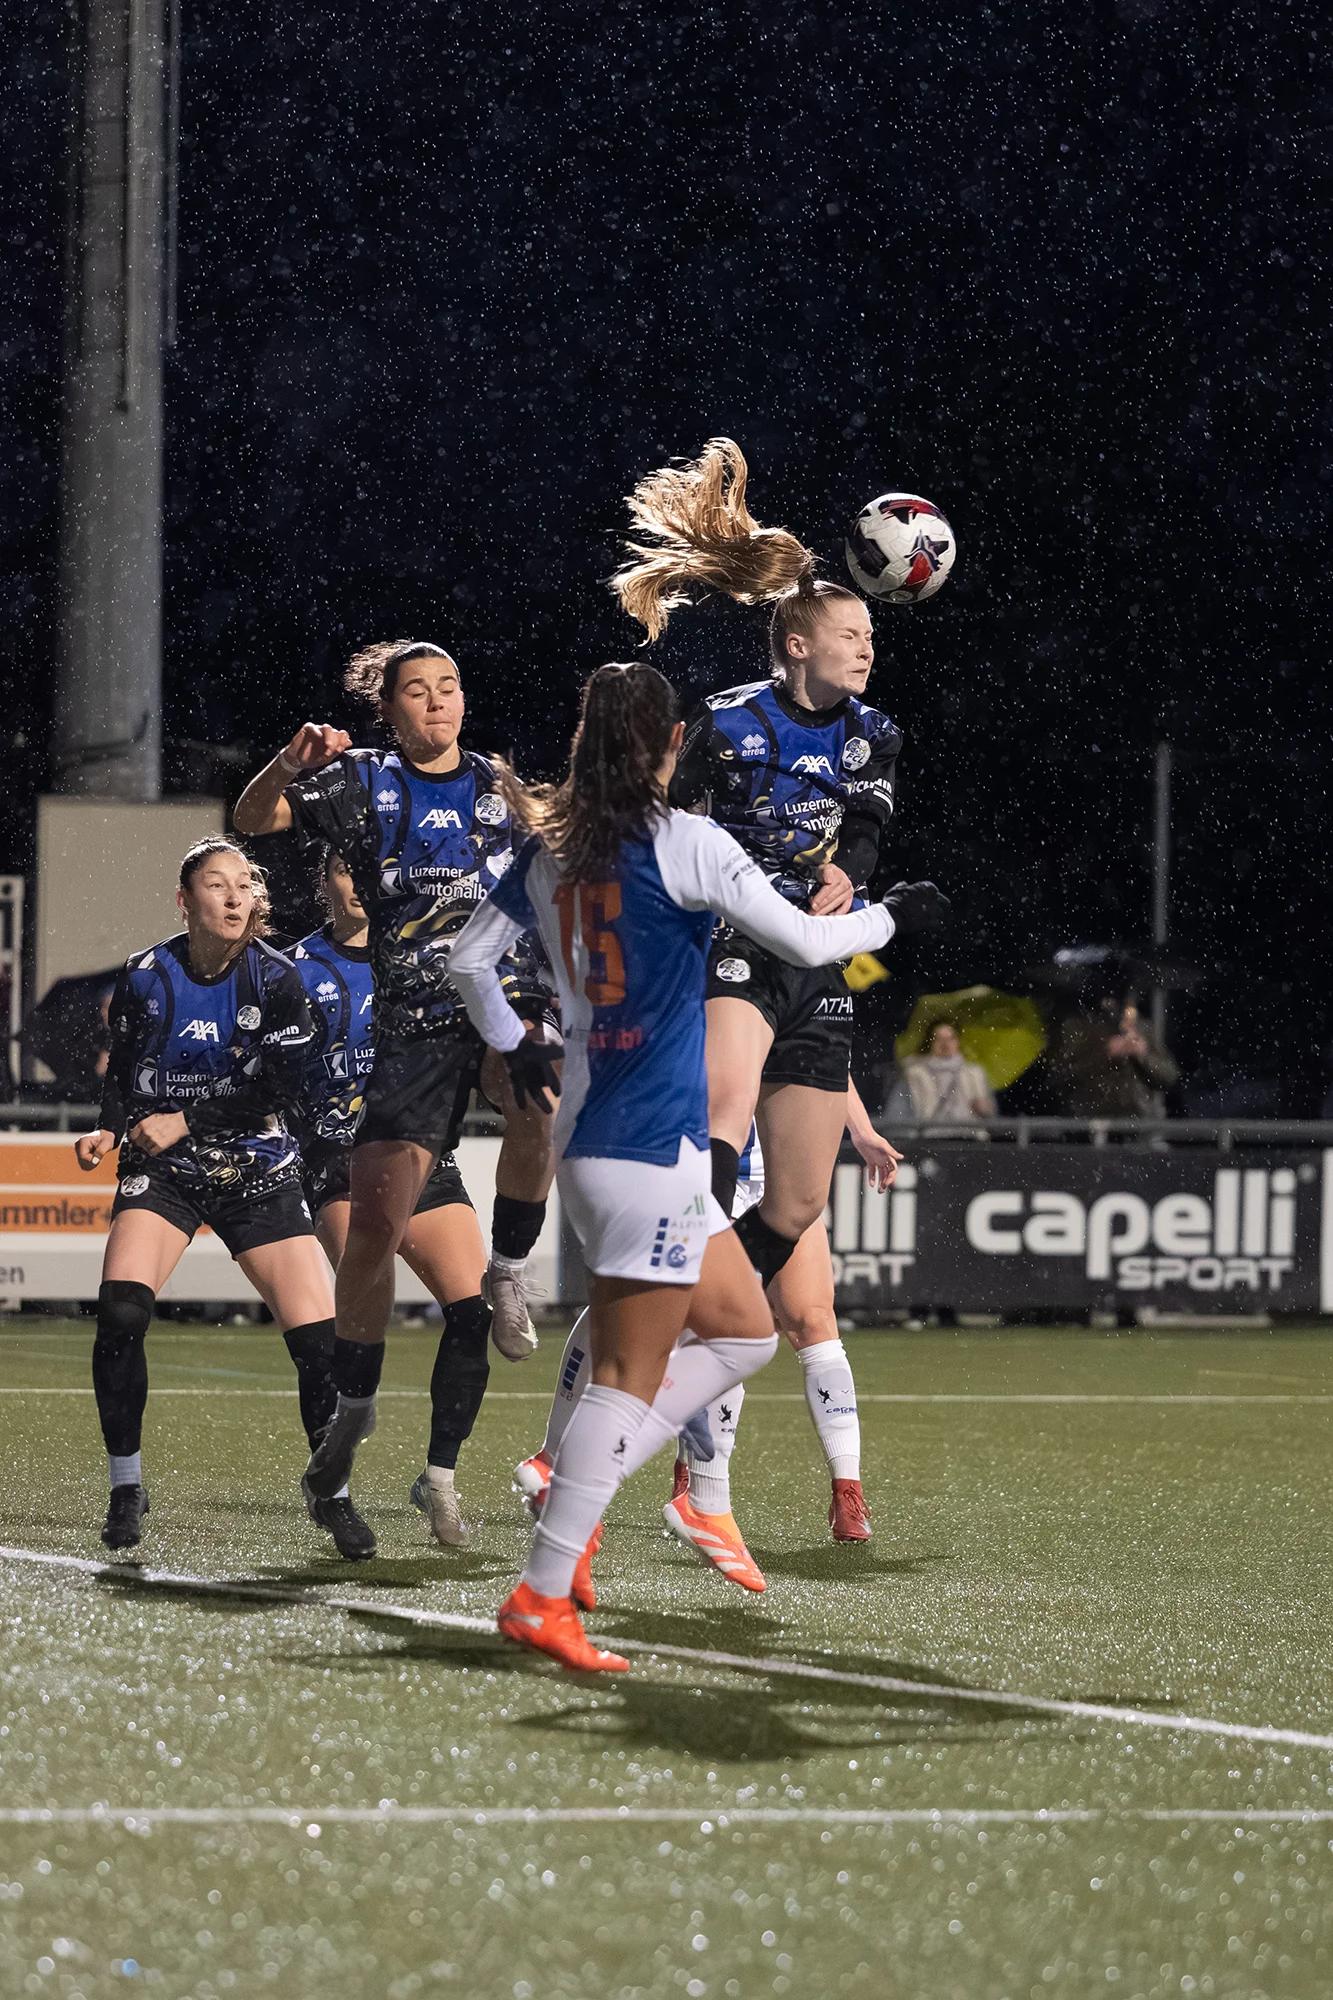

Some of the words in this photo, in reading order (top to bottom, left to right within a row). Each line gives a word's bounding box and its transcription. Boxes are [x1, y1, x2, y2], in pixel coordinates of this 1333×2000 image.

[788, 755, 834, 776] AXA
[784, 797, 838, 816] Luzerne
[418, 809, 462, 829] AXA
[409, 865, 464, 879] Luzerner
[178, 1019, 220, 1042] AXA
[965, 1168, 1297, 1280] capelli
[1117, 1256, 1293, 1291] SPORT
